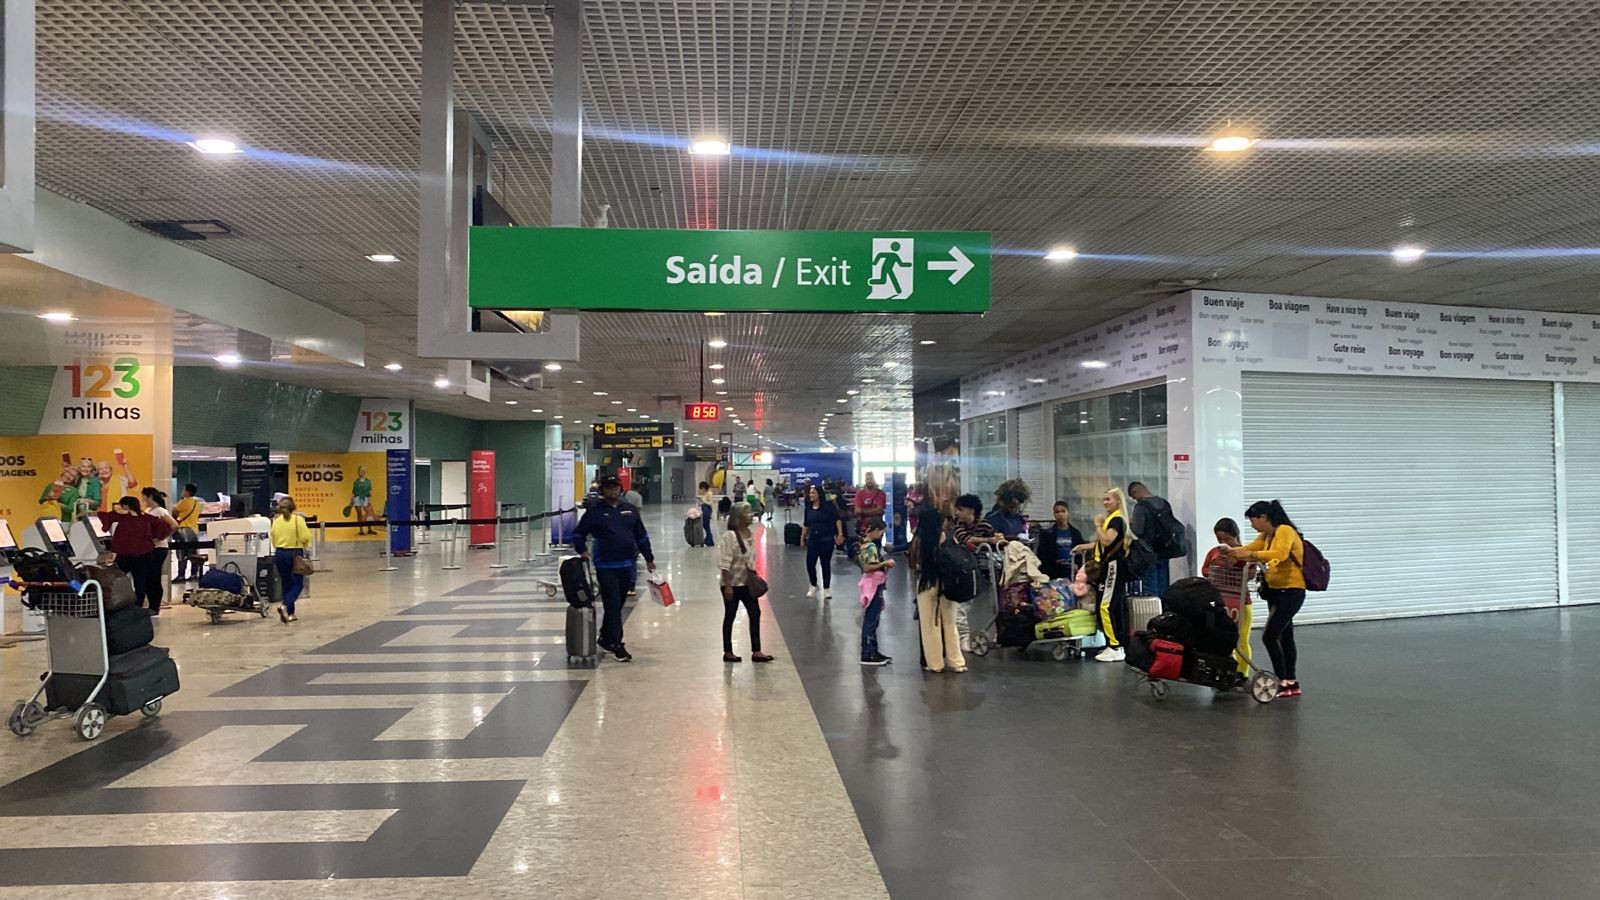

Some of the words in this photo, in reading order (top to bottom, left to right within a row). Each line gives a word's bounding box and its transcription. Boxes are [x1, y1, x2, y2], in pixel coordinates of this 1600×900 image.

[665, 254, 764, 286] Saída
[772, 257, 785, 288] /
[796, 257, 852, 286] Exit
[1203, 296, 1224, 307] Buen
[1226, 297, 1245, 310] viaje
[1269, 299, 1283, 310] Boa
[1284, 300, 1310, 313] viagem
[1326, 303, 1339, 313] Have
[1345, 305, 1356, 314] nice
[1357, 306, 1367, 317] trip
[1385, 308, 1402, 318] Buen
[1404, 309, 1420, 321] viaje
[1440, 312, 1452, 322] Boa
[1453, 313, 1476, 325] viagem
[1488, 315, 1501, 323] Have
[1506, 316, 1516, 324] nice
[1516, 317, 1525, 325] trip
[1542, 318, 1557, 327] Buen
[1559, 319, 1573, 330] viaje
[1208, 337, 1221, 348] Bon
[1333, 343, 1349, 353] Gute
[1350, 344, 1366, 353] reise
[1389, 346, 1401, 355] Bon
[1402, 349, 1424, 359] voyage
[1440, 350, 1452, 358] Bon
[1453, 352, 1474, 361] voyage
[1495, 352, 1509, 360] Gute
[1510, 352, 1524, 360] reise
[1545, 354, 1557, 362] Bon
[1558, 356, 1577, 365] voyage
[63, 358, 141, 398] 123
[63, 402, 141, 420] milhas
[361, 411, 403, 432] 123
[361, 433, 403, 444] milhas
[295, 470, 344, 482] TODOS
